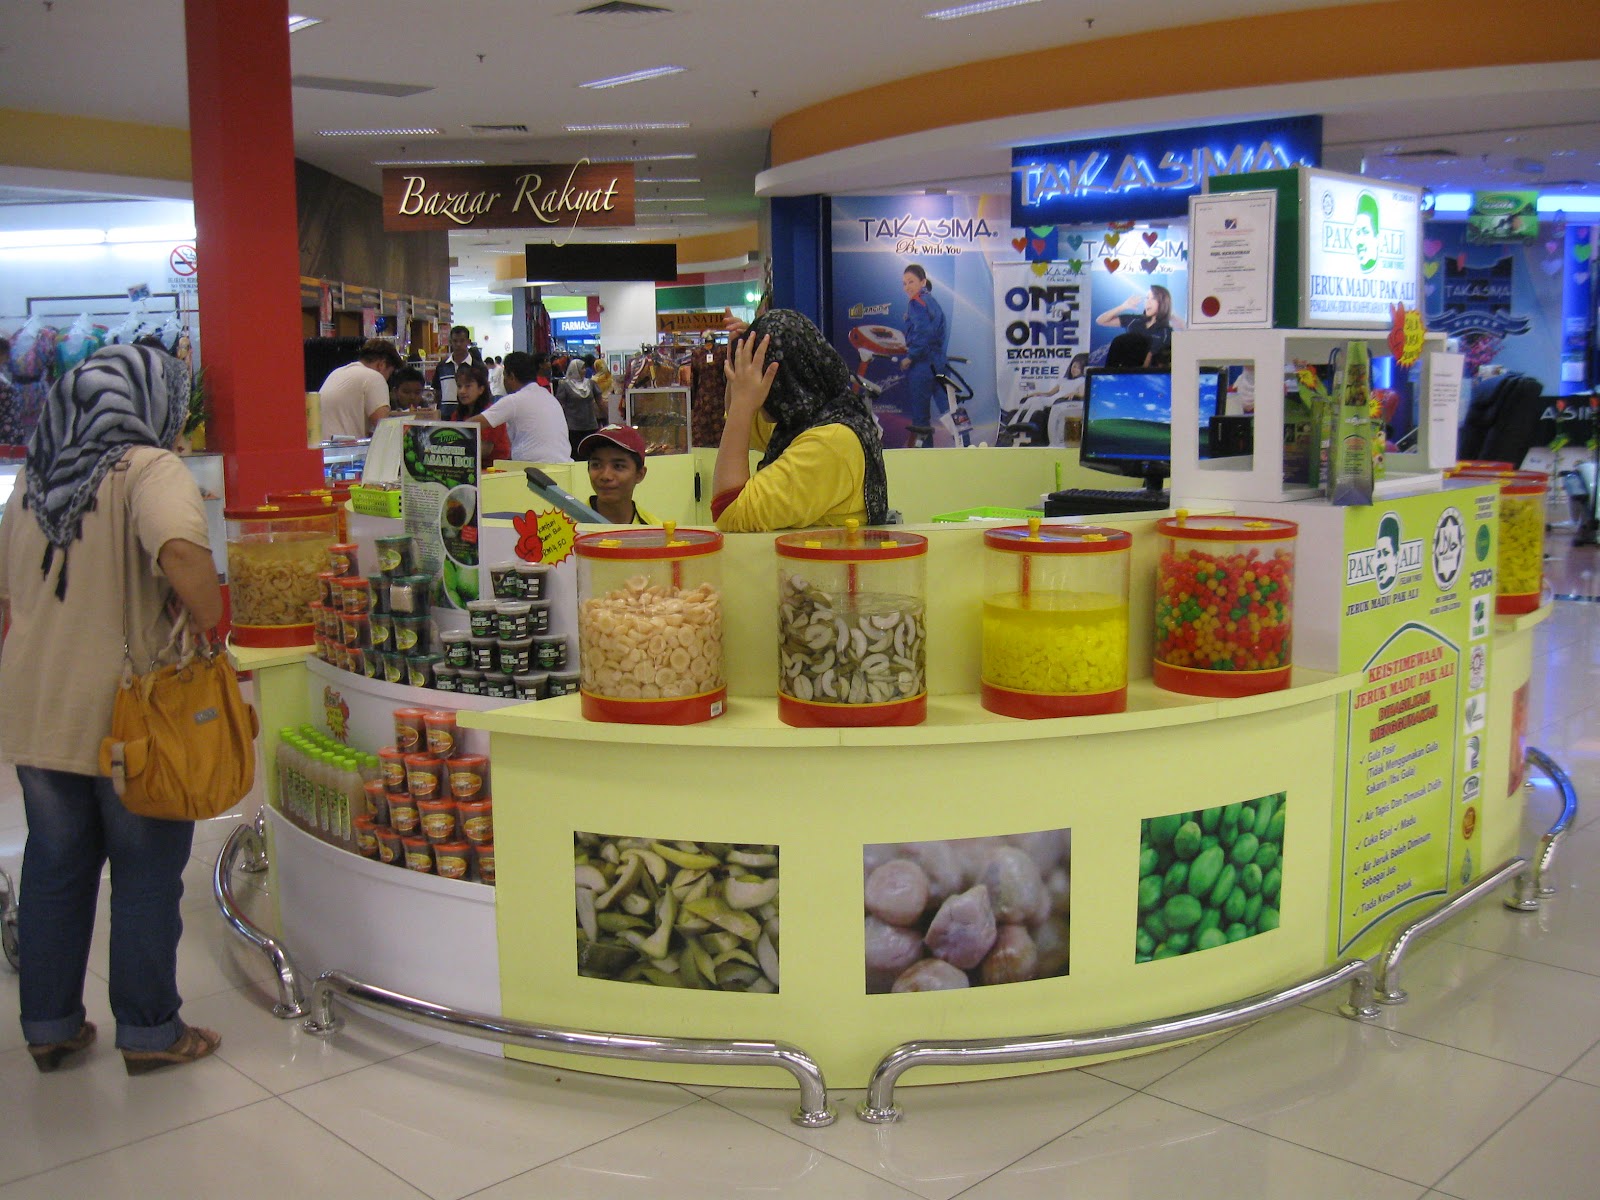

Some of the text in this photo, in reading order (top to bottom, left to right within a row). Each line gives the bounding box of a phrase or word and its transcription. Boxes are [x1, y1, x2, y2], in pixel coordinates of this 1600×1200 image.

[398, 157, 619, 247] Bazaar Rakyat
[859, 214, 992, 242] TAKASIMA
[1325, 225, 1403, 255] PAK ALI
[1005, 285, 1080, 312] ONE
[1310, 275, 1415, 300] JERUK MADU PAK ALI
[1005, 321, 1080, 346] ONE
[1007, 348, 1072, 359] EXCHANGE
[1021, 366, 1060, 375] FREE
[1348, 545, 1423, 580] PAK ALI
[1346, 601, 1370, 616] JERUK
[1371, 595, 1392, 609] MADU
[1393, 591, 1407, 604] PAK
[1407, 588, 1419, 600] ALI
[1368, 645, 1444, 683] KEISTIMEWAAN
[1354, 662, 1455, 709] JERUK MADU PAK ALI
[1369, 704, 1438, 743] MENGGUNAKAN
[1385, 748, 1425, 770] Menggunakan
